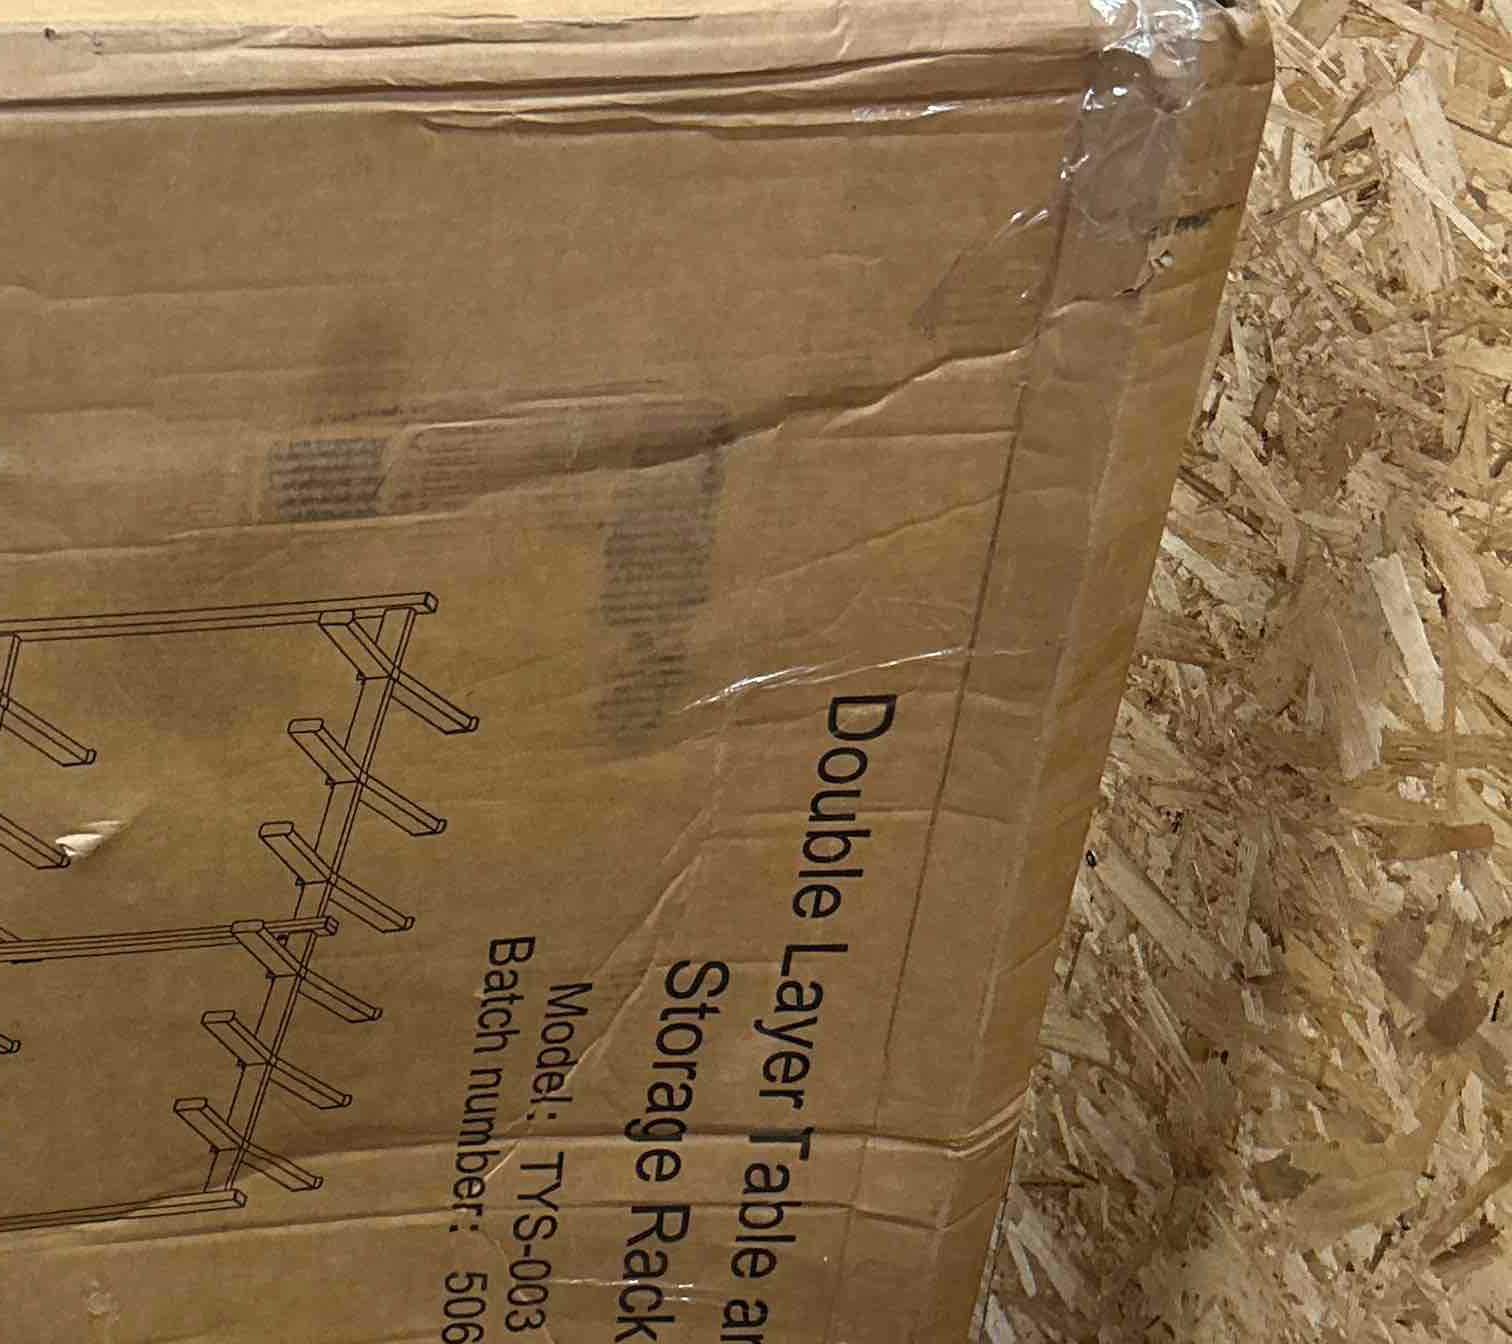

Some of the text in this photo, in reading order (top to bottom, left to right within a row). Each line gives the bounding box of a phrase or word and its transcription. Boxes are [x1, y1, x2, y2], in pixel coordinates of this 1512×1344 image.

[791, 694, 897, 919] Double
[473, 935, 536, 1055] Batch
[753, 943, 849, 1111] Layer
[448, 1066, 504, 1233] number:
[504, 981, 593, 1334] Model: TYS-003
[614, 959, 730, 1344] Storage Rack
[729, 1126, 814, 1280] Table
